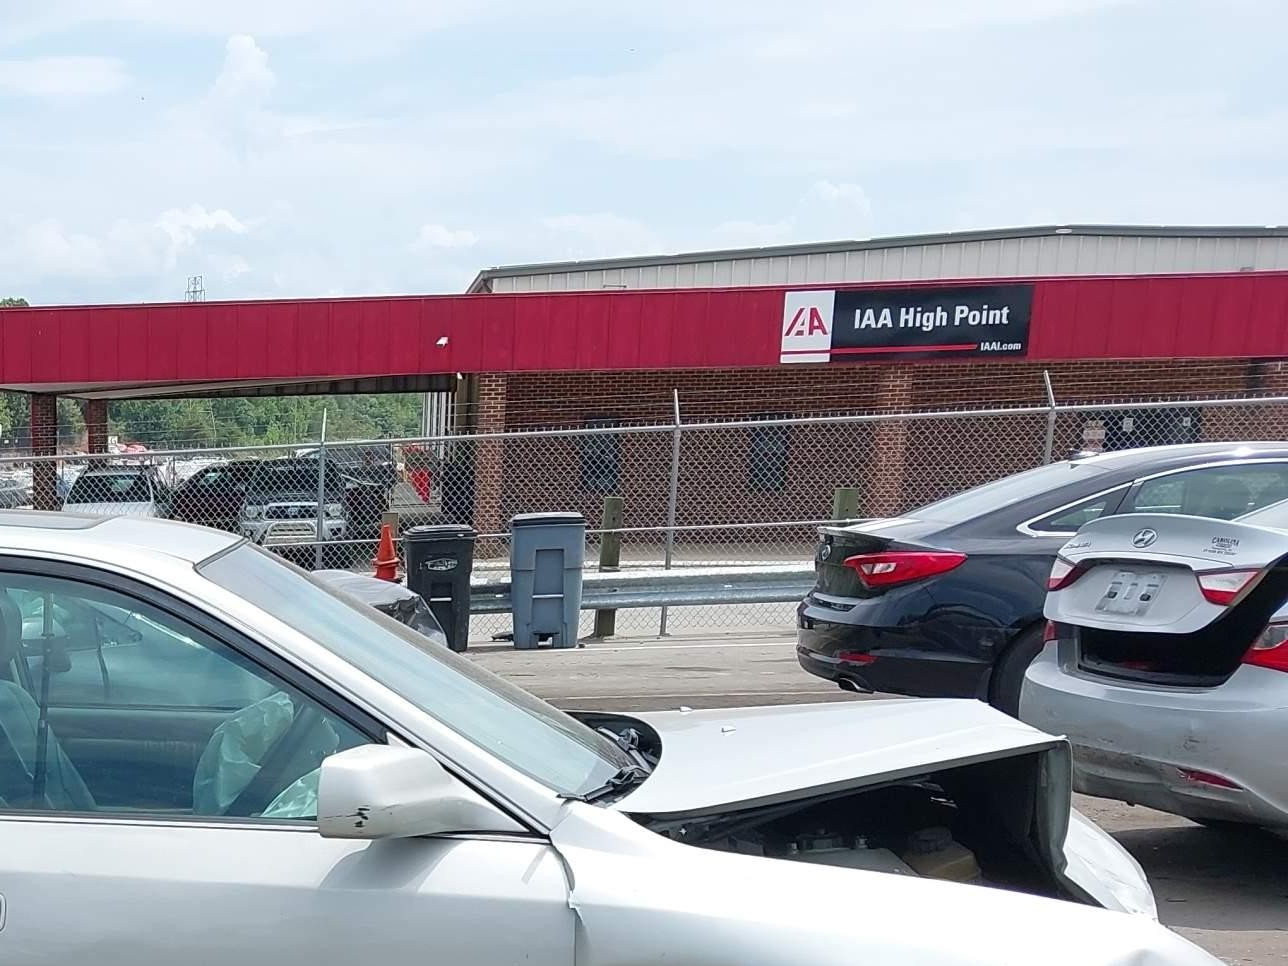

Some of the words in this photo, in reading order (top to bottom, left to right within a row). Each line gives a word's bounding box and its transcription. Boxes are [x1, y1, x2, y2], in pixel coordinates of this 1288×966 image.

[853, 308, 893, 329] IAA
[899, 306, 948, 332] High
[954, 304, 1010, 327] Point
[980, 341, 1022, 352] IAAI.com
